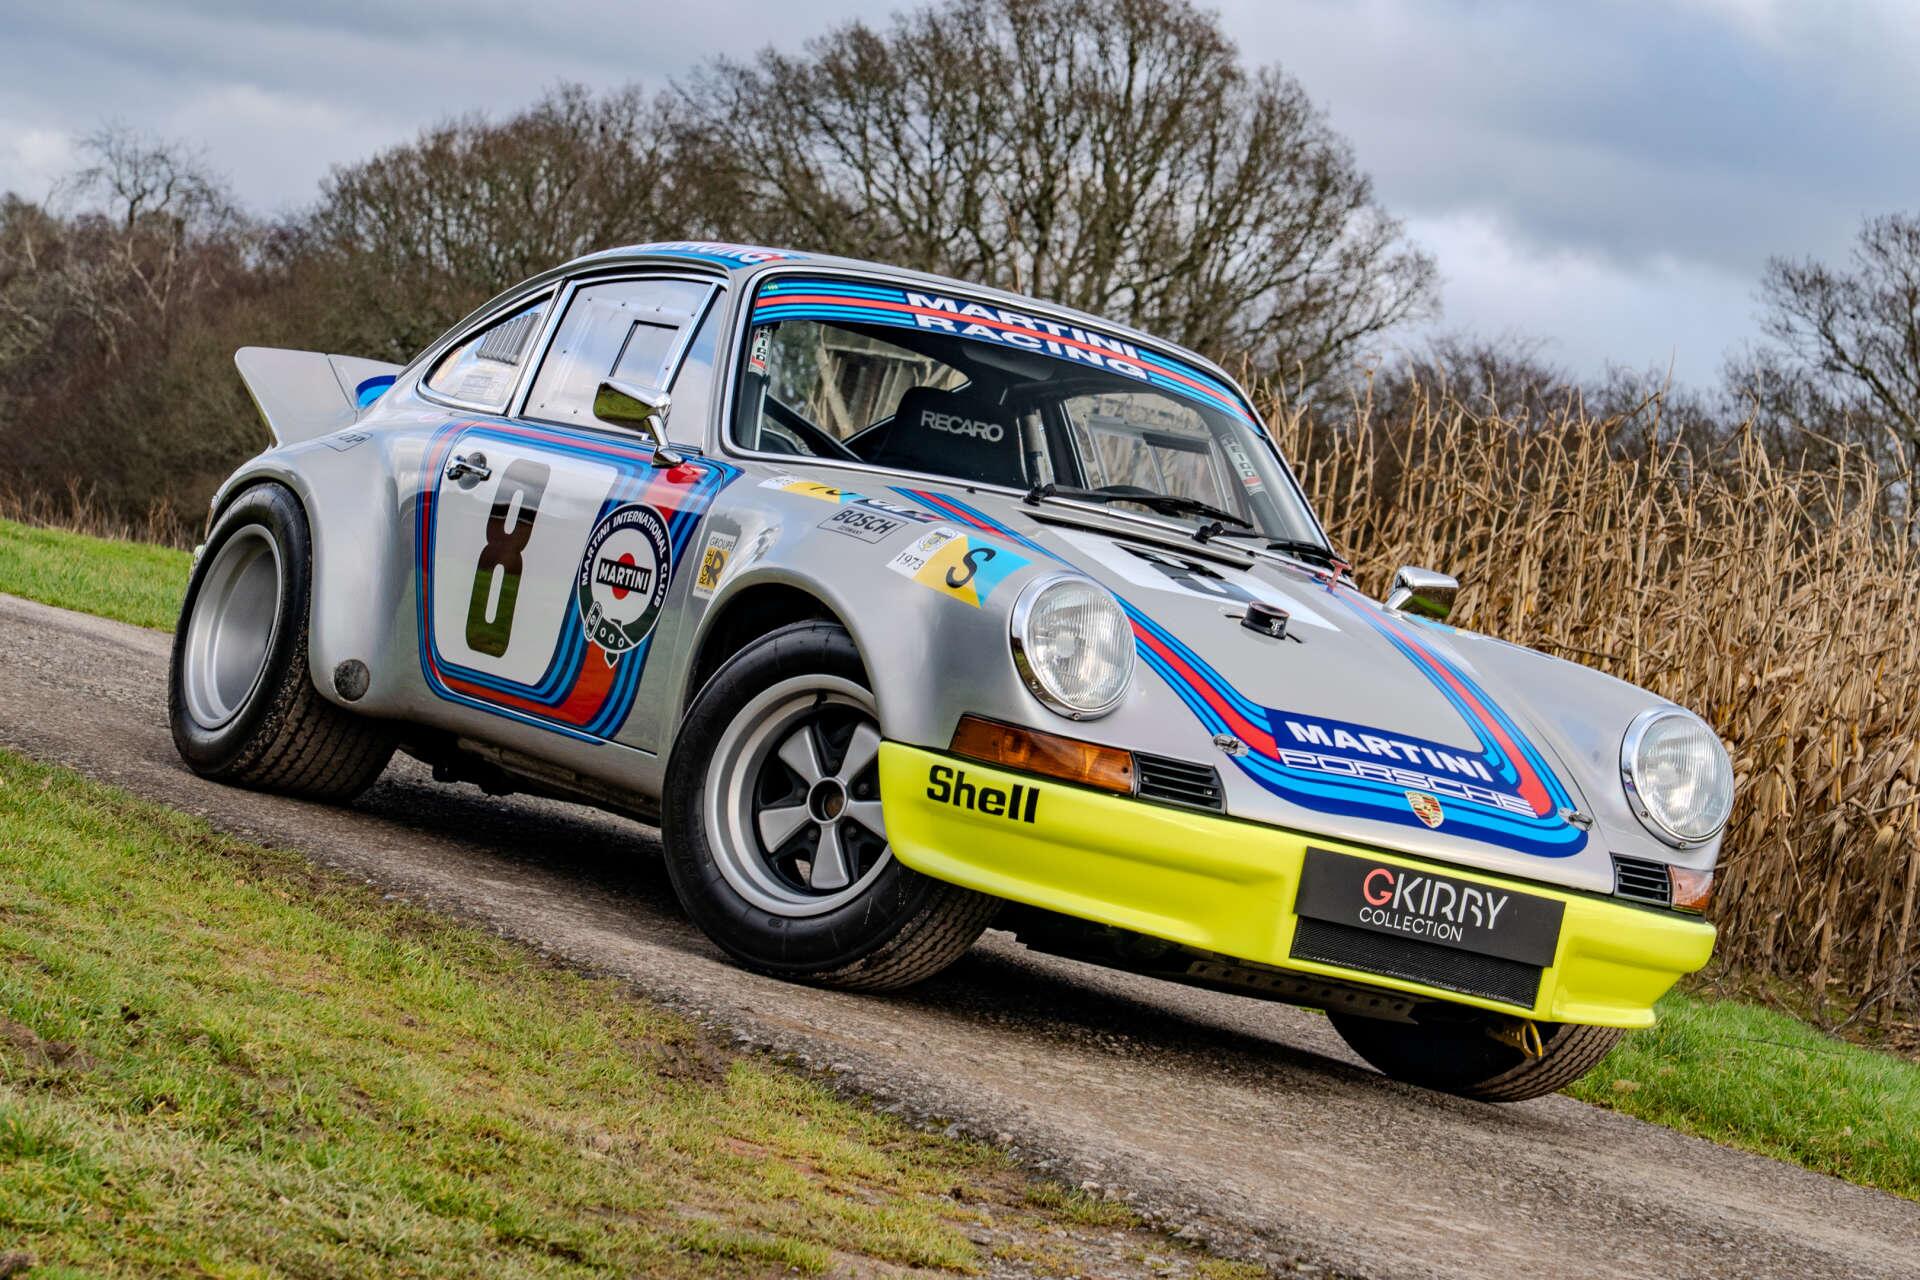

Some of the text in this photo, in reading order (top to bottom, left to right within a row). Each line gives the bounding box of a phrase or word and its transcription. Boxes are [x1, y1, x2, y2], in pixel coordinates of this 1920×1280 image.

[906, 292, 1138, 359] MARTINI
[915, 314, 1148, 380] RACING
[921, 410, 1004, 442] RECARO
[832, 510, 898, 535] BOSCH
[466, 458, 551, 659] 8
[581, 510, 668, 608] MARTINI INTERNATIONAL CLUB
[598, 562, 650, 591] MARTINI
[699, 550, 715, 585] ROSE
[896, 552, 925, 570] 1973
[945, 547, 996, 589] S
[1285, 720, 1494, 782] MARTINI
[926, 764, 1040, 825] Shell
[1277, 747, 1539, 819] PORSCHE
[1359, 906, 1463, 942] COLLECTION
